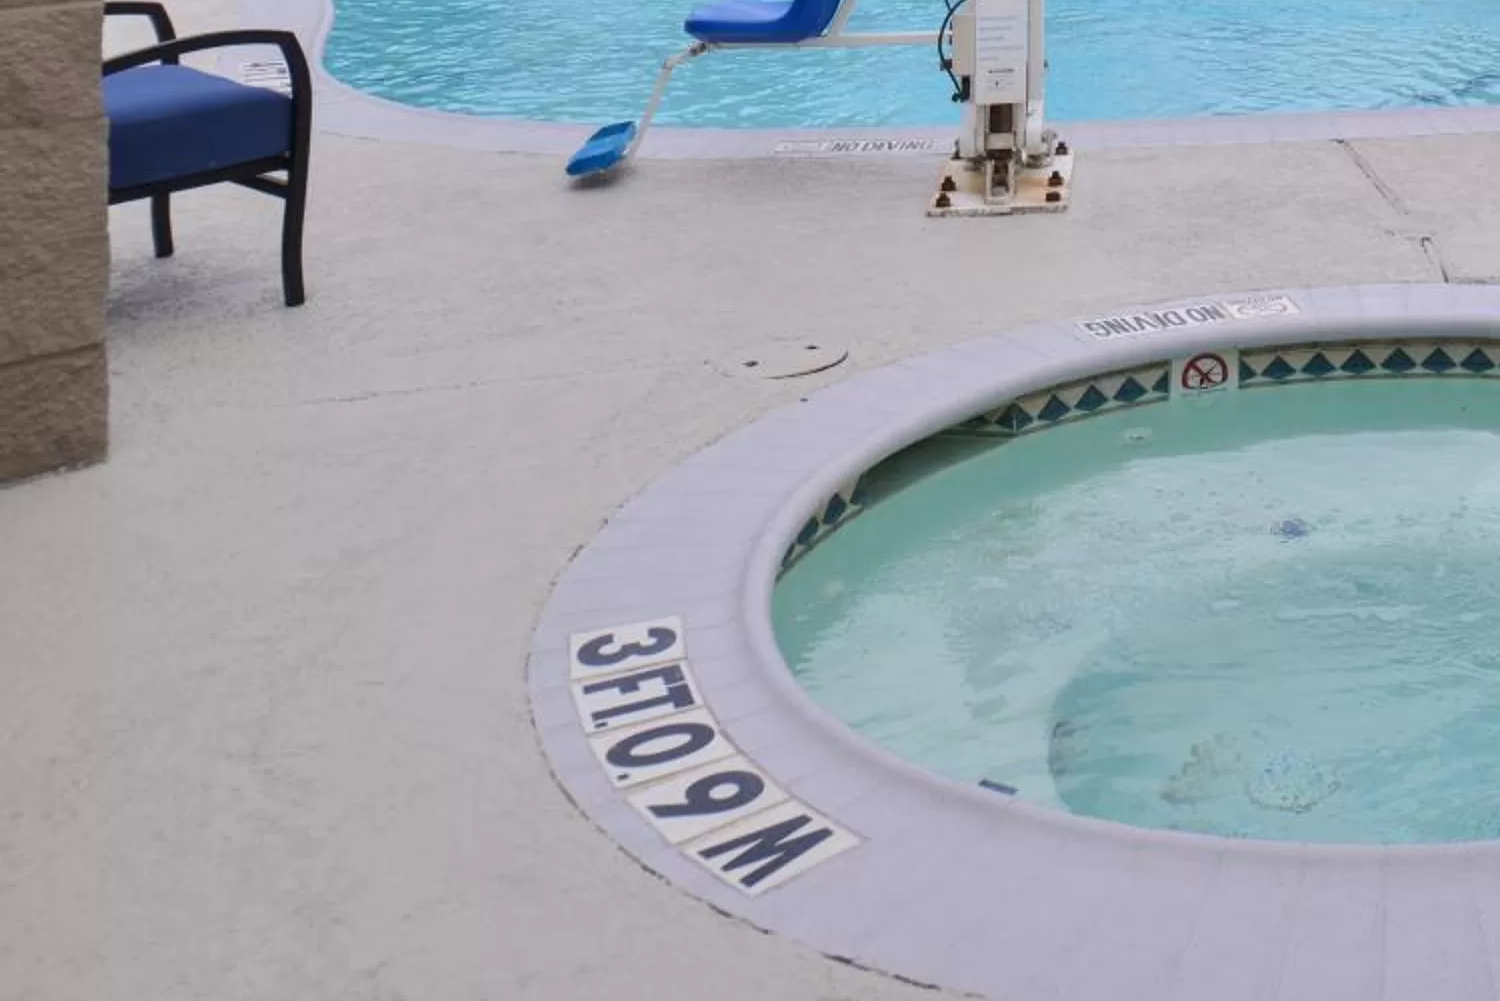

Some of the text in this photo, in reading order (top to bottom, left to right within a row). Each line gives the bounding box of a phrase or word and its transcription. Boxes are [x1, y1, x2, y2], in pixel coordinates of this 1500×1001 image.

[1084, 304, 1228, 337] NO DIVING
[576, 626, 678, 667] 3
[697, 813, 834, 888] M
